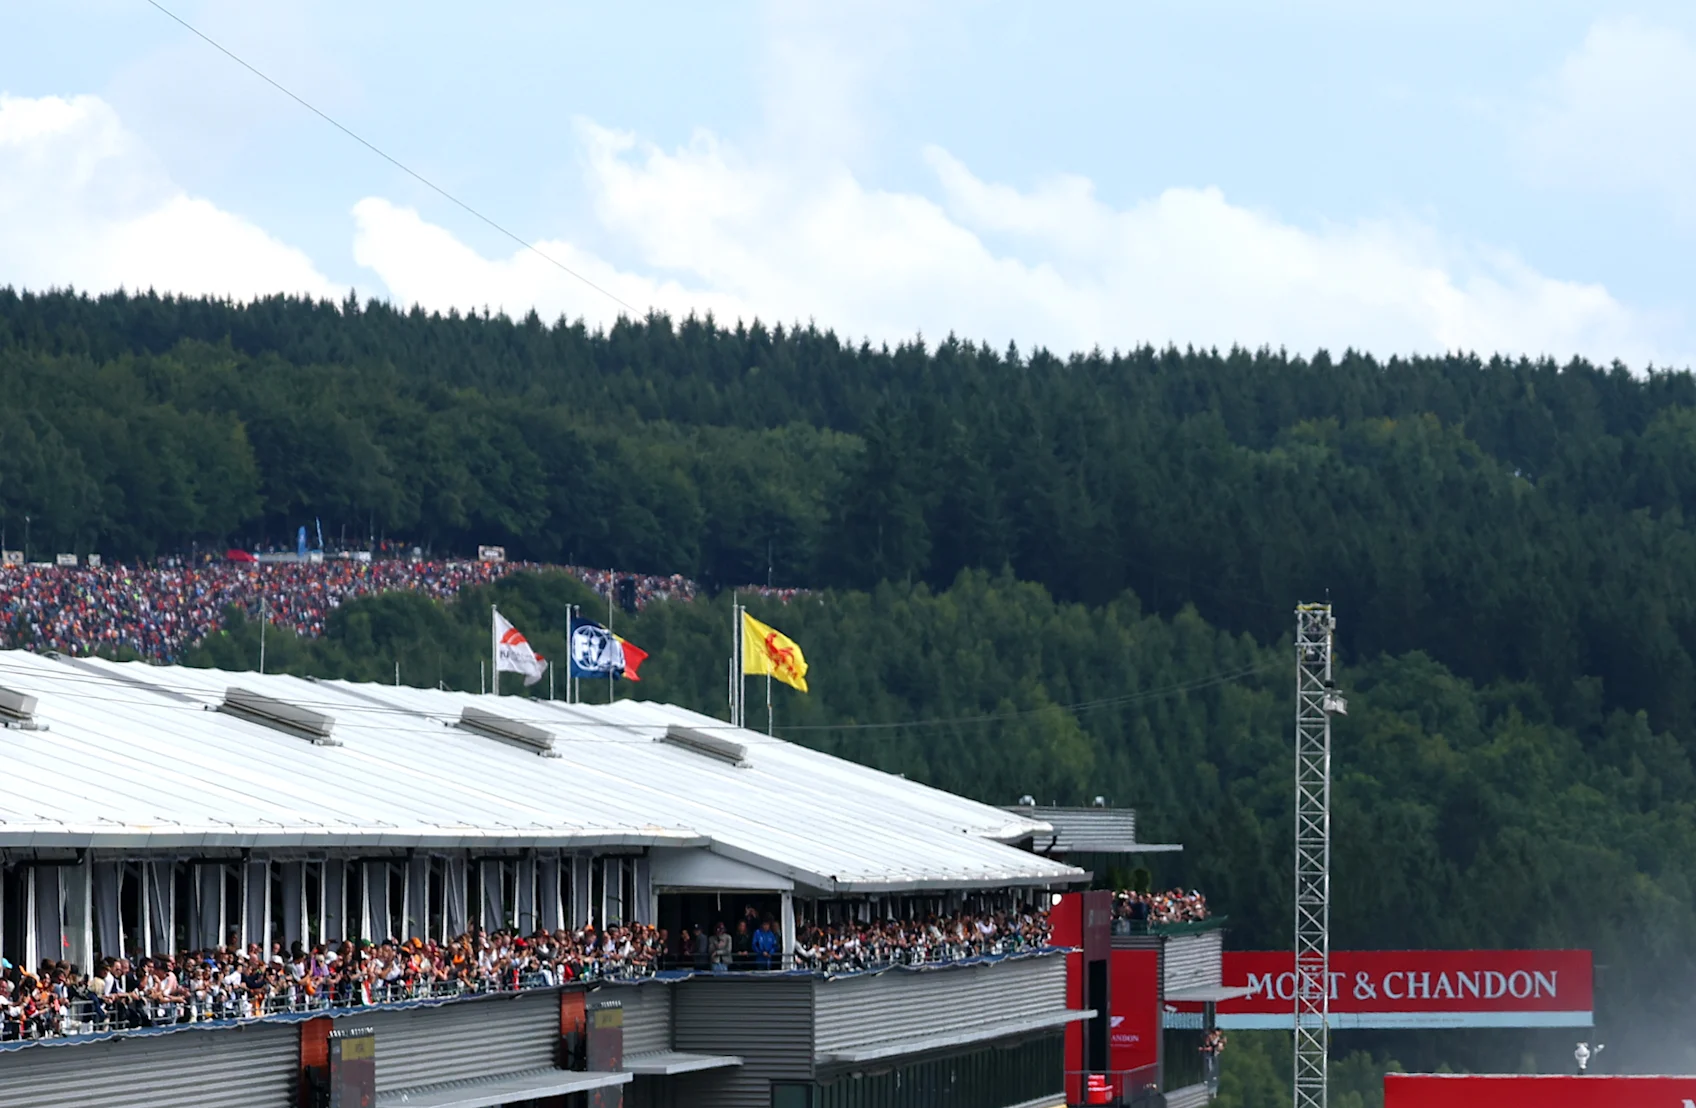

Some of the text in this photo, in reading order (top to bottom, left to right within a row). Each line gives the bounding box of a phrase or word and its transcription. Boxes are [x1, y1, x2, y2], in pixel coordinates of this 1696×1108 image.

[1246, 965, 1558, 1000] MOËT & CHANDON
[1111, 1034, 1139, 1042] ANDON
